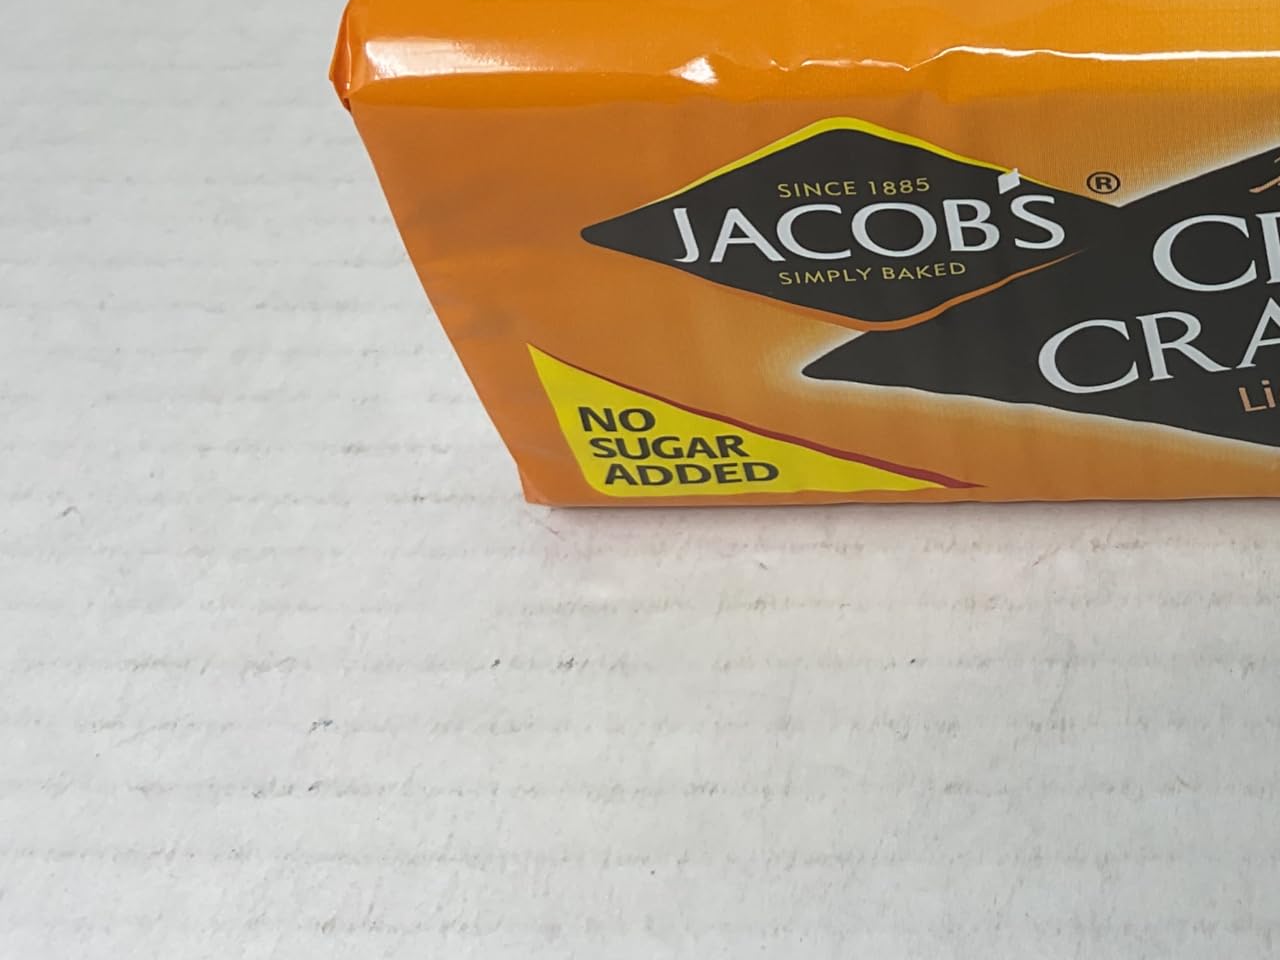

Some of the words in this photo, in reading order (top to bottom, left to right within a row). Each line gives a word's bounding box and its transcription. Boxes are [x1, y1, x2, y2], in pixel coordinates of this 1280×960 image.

[777, 180, 856, 198] SINCE
[868, 177, 931, 195] 1885
[672, 168, 1066, 264] JACOB'S
[779, 267, 872, 286] SIMPLY
[882, 262, 966, 280] BAKED
[578, 406, 656, 433] NO
[589, 434, 750, 460] SUGAR
[604, 461, 780, 486] ADDED
